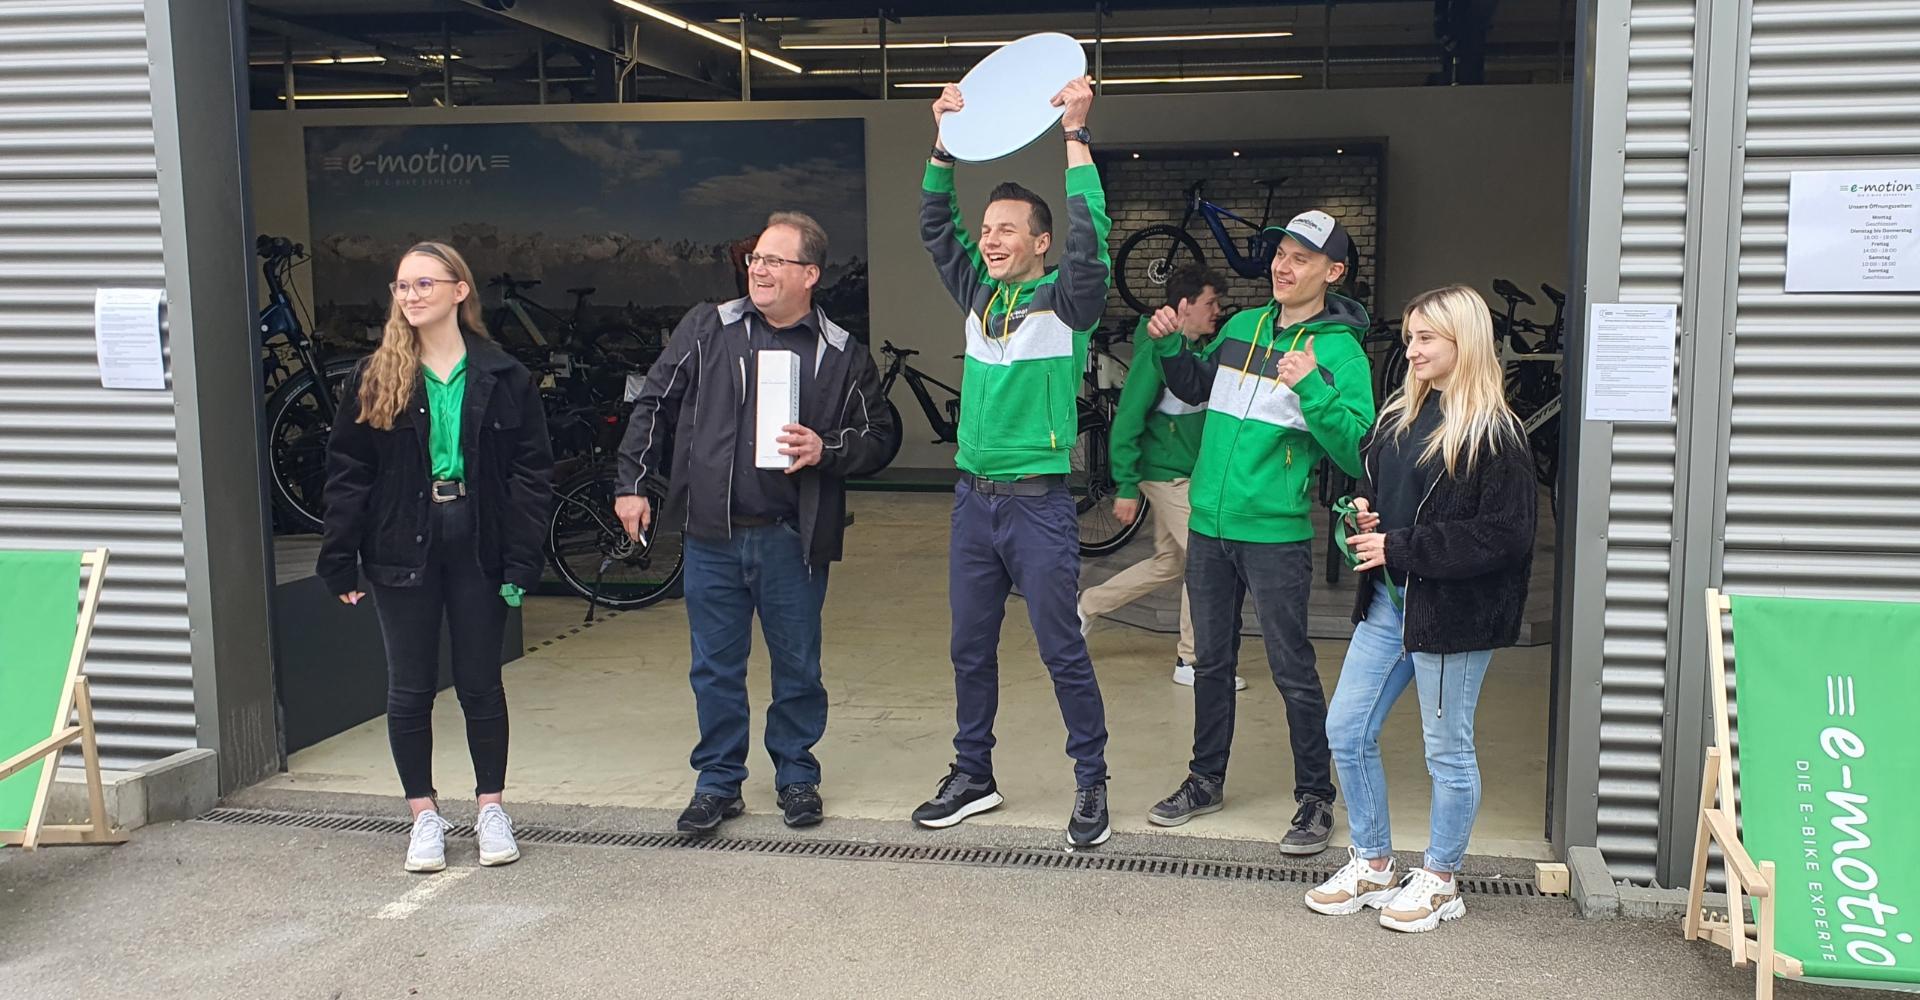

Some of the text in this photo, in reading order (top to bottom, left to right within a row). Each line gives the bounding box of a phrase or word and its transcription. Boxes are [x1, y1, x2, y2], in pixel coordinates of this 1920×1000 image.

[348, 143, 486, 174] e-motion
[1850, 180, 1913, 192] e-motion
[1796, 760, 1838, 963] DIE E-BIKE EXPERTE
